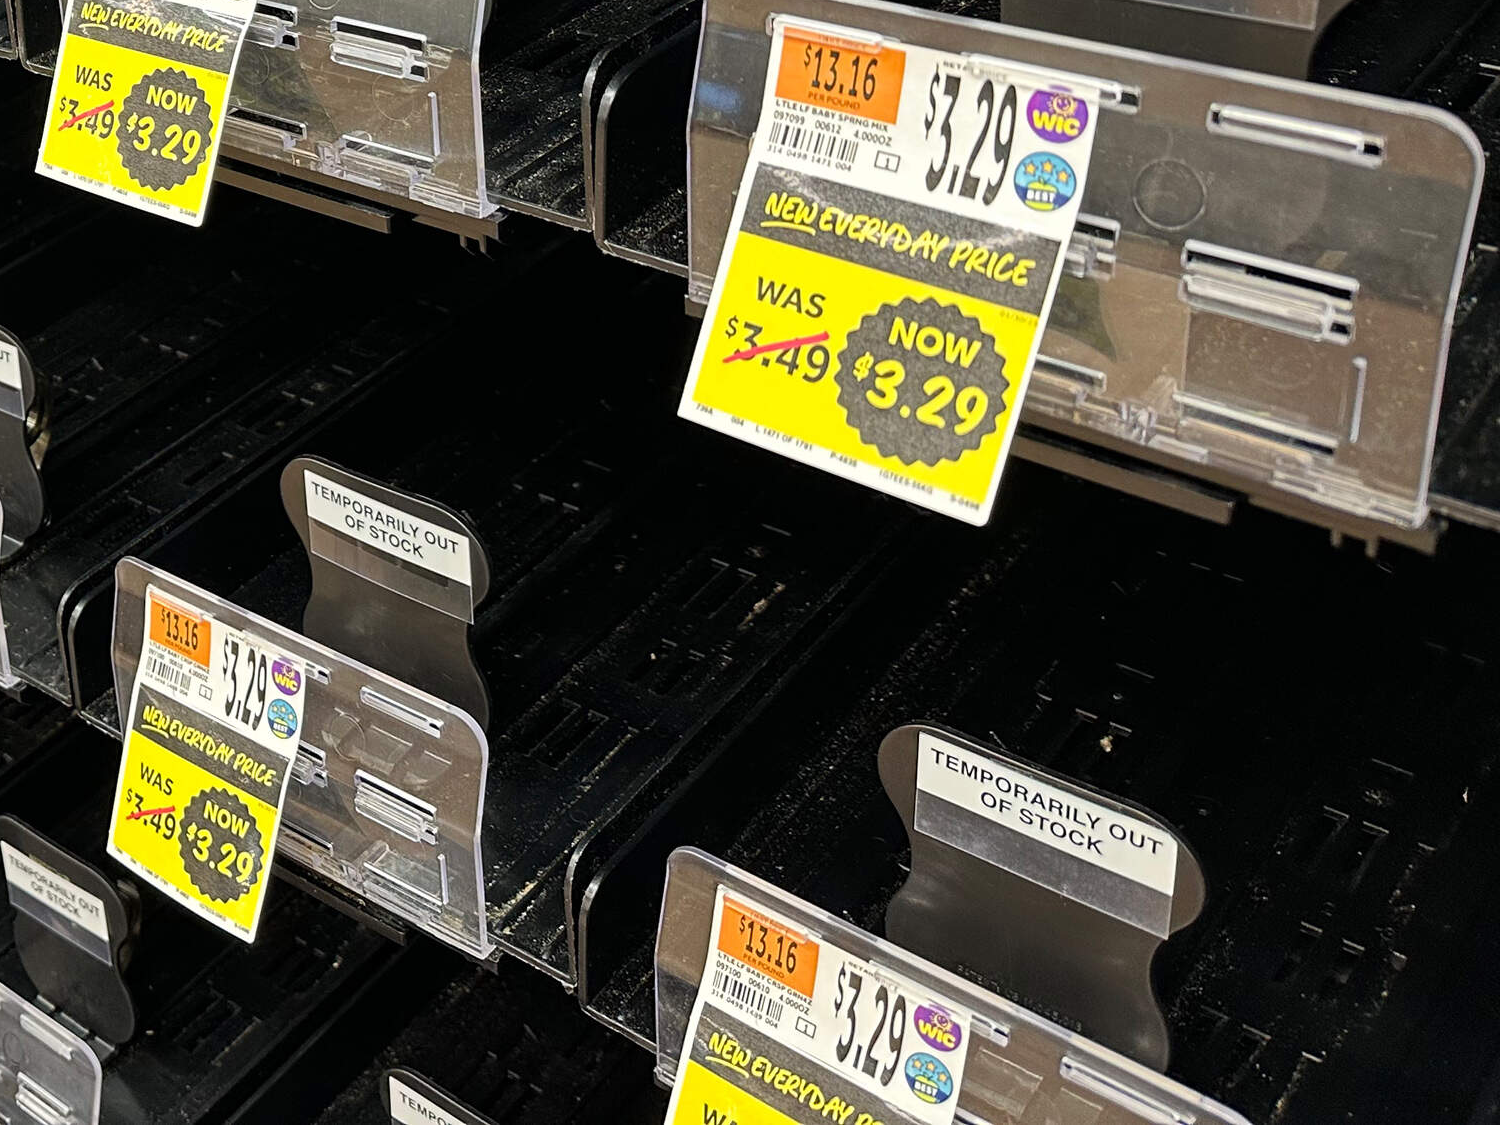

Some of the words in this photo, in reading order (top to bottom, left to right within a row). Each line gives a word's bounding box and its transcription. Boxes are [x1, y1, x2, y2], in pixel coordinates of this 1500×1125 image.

[81, 1, 110, 28] NEW
[110, 7, 182, 43] EVERYDAY
[181, 24, 230, 54] PRICE
[75, 64, 113, 93] WAS
[804, 43, 879, 102] $13.16
[59, 96, 115, 140] $3.49
[146, 84, 198, 116] NOW
[773, 110, 805, 126] 097099
[815, 119, 842, 135] 00612
[775, 98, 798, 112] LTLE
[799, 104, 810, 115] LF
[812, 107, 836, 121] BABY
[839, 113, 869, 129] SPRNG
[871, 120, 889, 133] MIX
[808, 91, 825, 104] PER
[826, 94, 861, 111] POUND
[127, 112, 201, 165] $3.29
[924, 62, 1017, 206] $3.29
[1032, 108, 1082, 138] WIC
[1026, 188, 1057, 204] BEST
[764, 191, 818, 225] NEW
[818, 206, 950, 262] EVERYDAY
[949, 241, 1037, 287] PRICE
[756, 275, 827, 319] WAS
[724, 315, 831, 384] $3.49
[888, 316, 982, 369] NOW
[852, 351, 989, 437] $3.29
[311, 481, 419, 538] TEMPORARILY
[424, 530, 459, 555] OUT
[345, 514, 365, 532] OF
[369, 524, 424, 560] STOCK
[161, 607, 199, 651] $13.16
[222, 631, 268, 732] $3.29
[274, 671, 299, 693] WIC
[143, 704, 169, 732] NEW
[169, 717, 234, 765] EVERYDAY
[233, 749, 277, 788] PRICE
[272, 721, 290, 734] BEST
[140, 761, 174, 797] WAS
[930, 747, 1102, 831] TEMPORARILY
[1108, 822, 1164, 855] OUT
[126, 787, 176, 842] $3.49
[203, 798, 250, 839] NOW
[980, 791, 1013, 814] OF
[1018, 807, 1104, 856] STOCK
[185, 821, 255, 884] $3.29
[739, 914, 799, 974] $13.16
[742, 952, 758, 966] PER
[758, 960, 785, 980] POUND
[716, 960, 742, 980] 097100
[717, 951, 736, 966] LTLE
[736, 959, 745, 970] LF
[746, 967, 766, 982] BABY
[766, 976, 787, 992] CRSP
[834, 962, 907, 1087] $3.29
[918, 1018, 956, 1049] WIC
[708, 1031, 749, 1069] NEW
[751, 1056, 856, 1125] EVERYDAY
[913, 1079, 940, 1097] BEST
